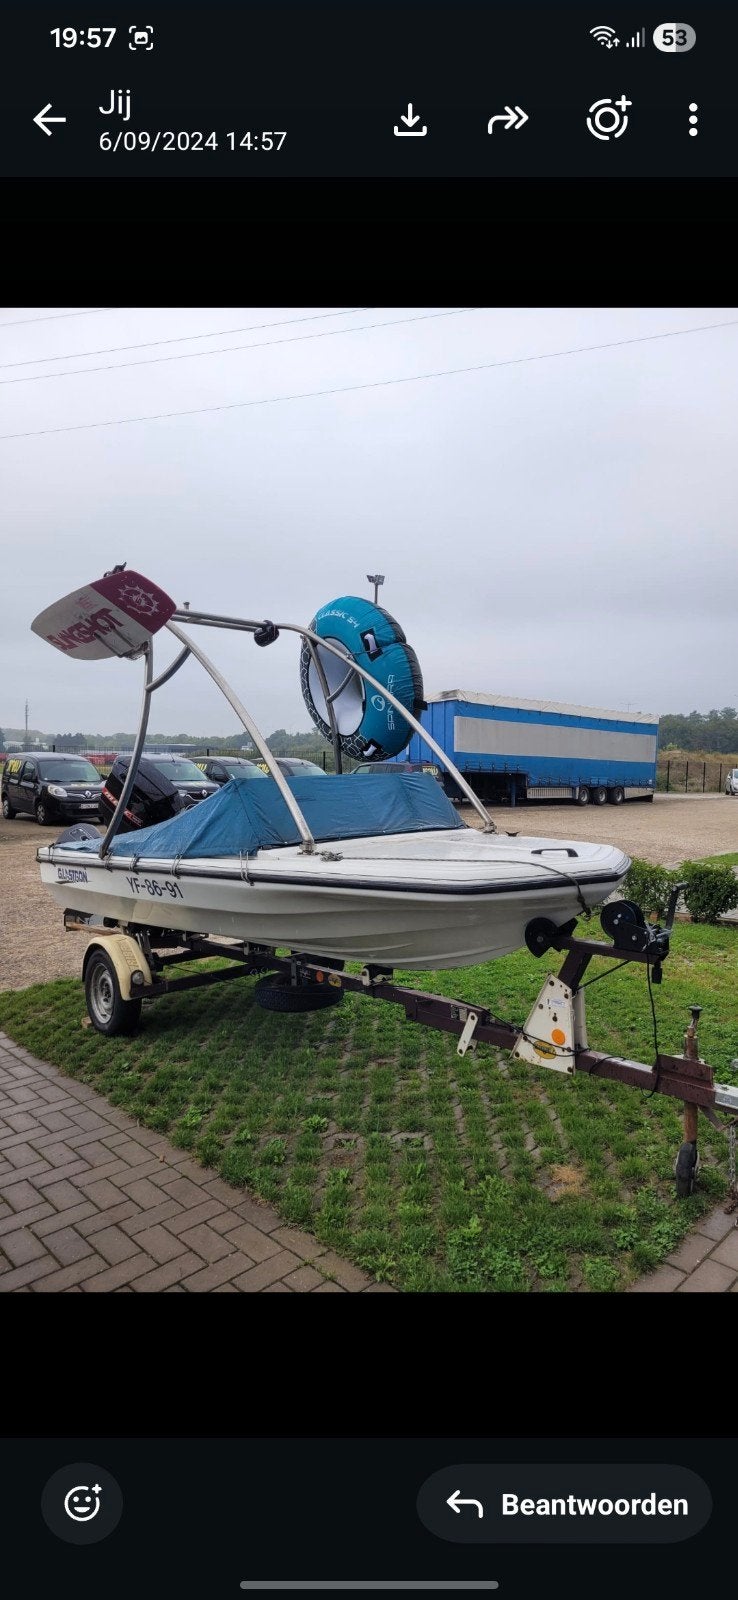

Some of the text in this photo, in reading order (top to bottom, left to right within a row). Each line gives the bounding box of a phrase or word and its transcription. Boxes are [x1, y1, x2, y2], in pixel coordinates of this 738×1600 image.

[317, 609, 360, 628] CLASSIC 54
[126, 876, 183, 899] YF-86-91
